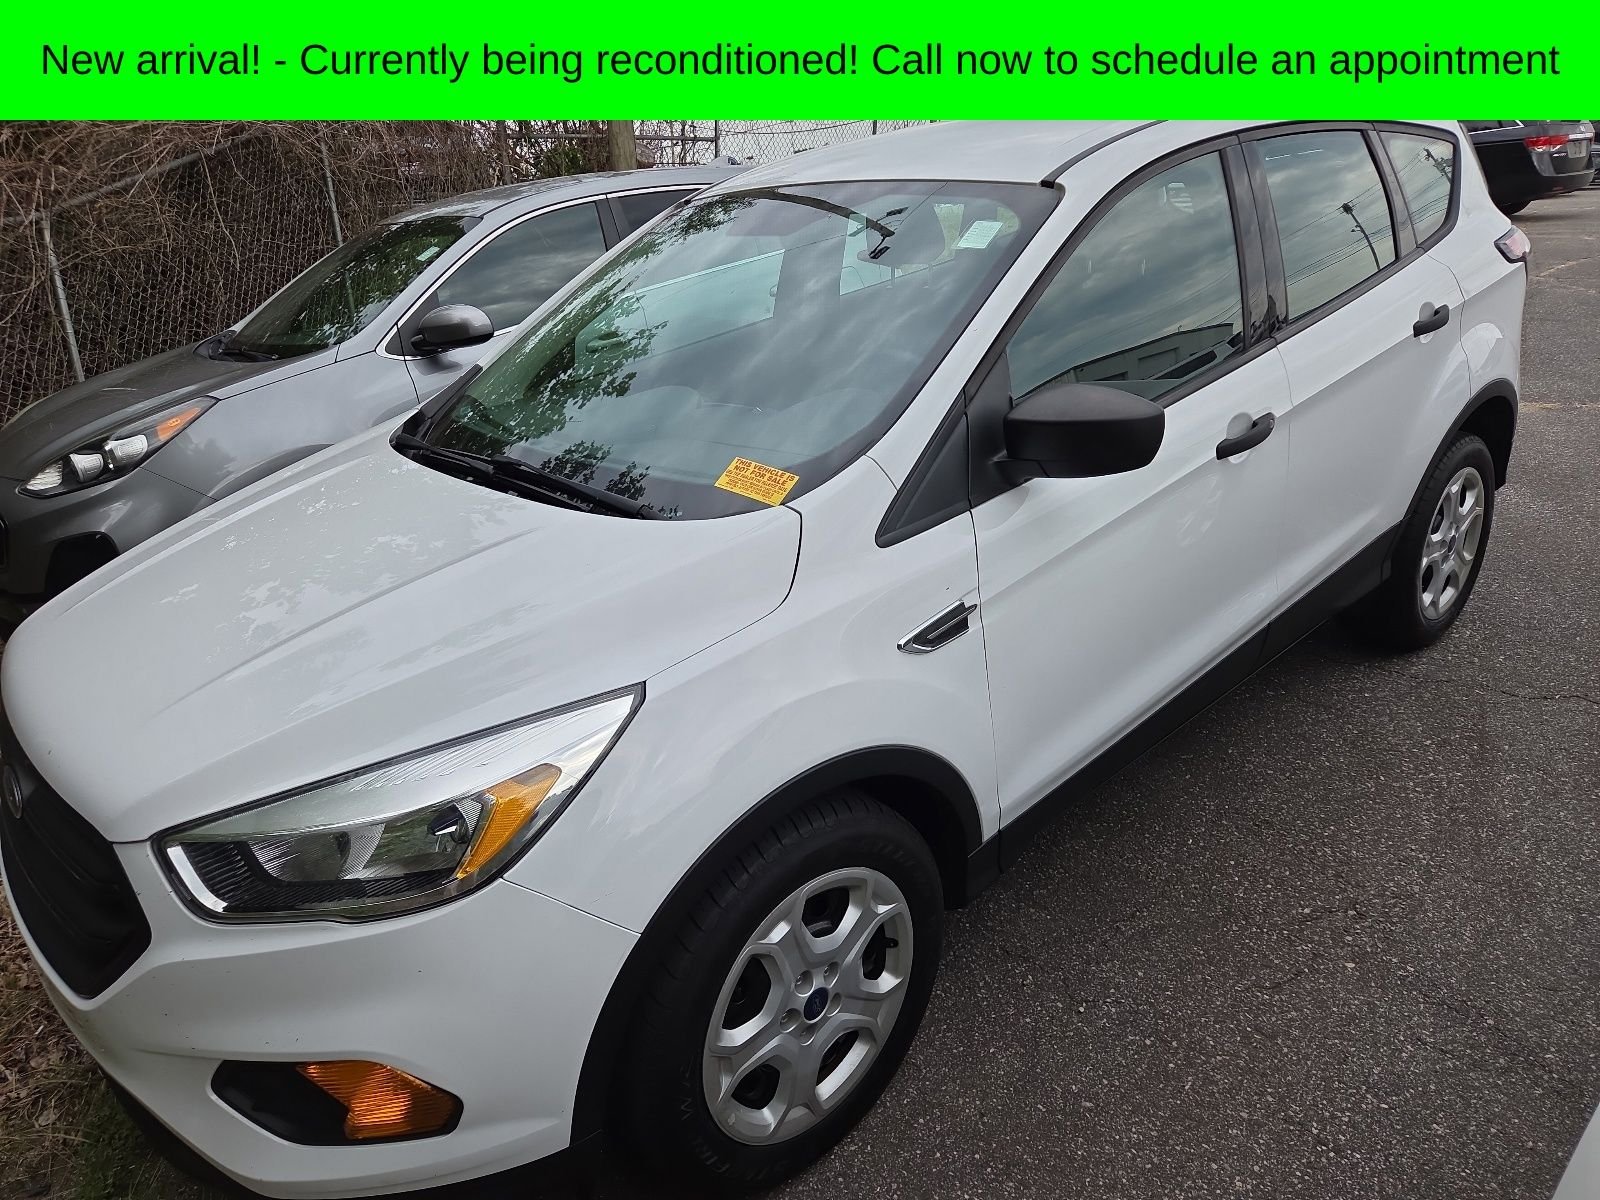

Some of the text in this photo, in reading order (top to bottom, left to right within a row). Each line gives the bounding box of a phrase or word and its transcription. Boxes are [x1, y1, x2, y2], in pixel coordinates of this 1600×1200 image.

[733, 465, 789, 486] NOT FOR SALE
[735, 458, 796, 482] THIS VEHICLE IS
